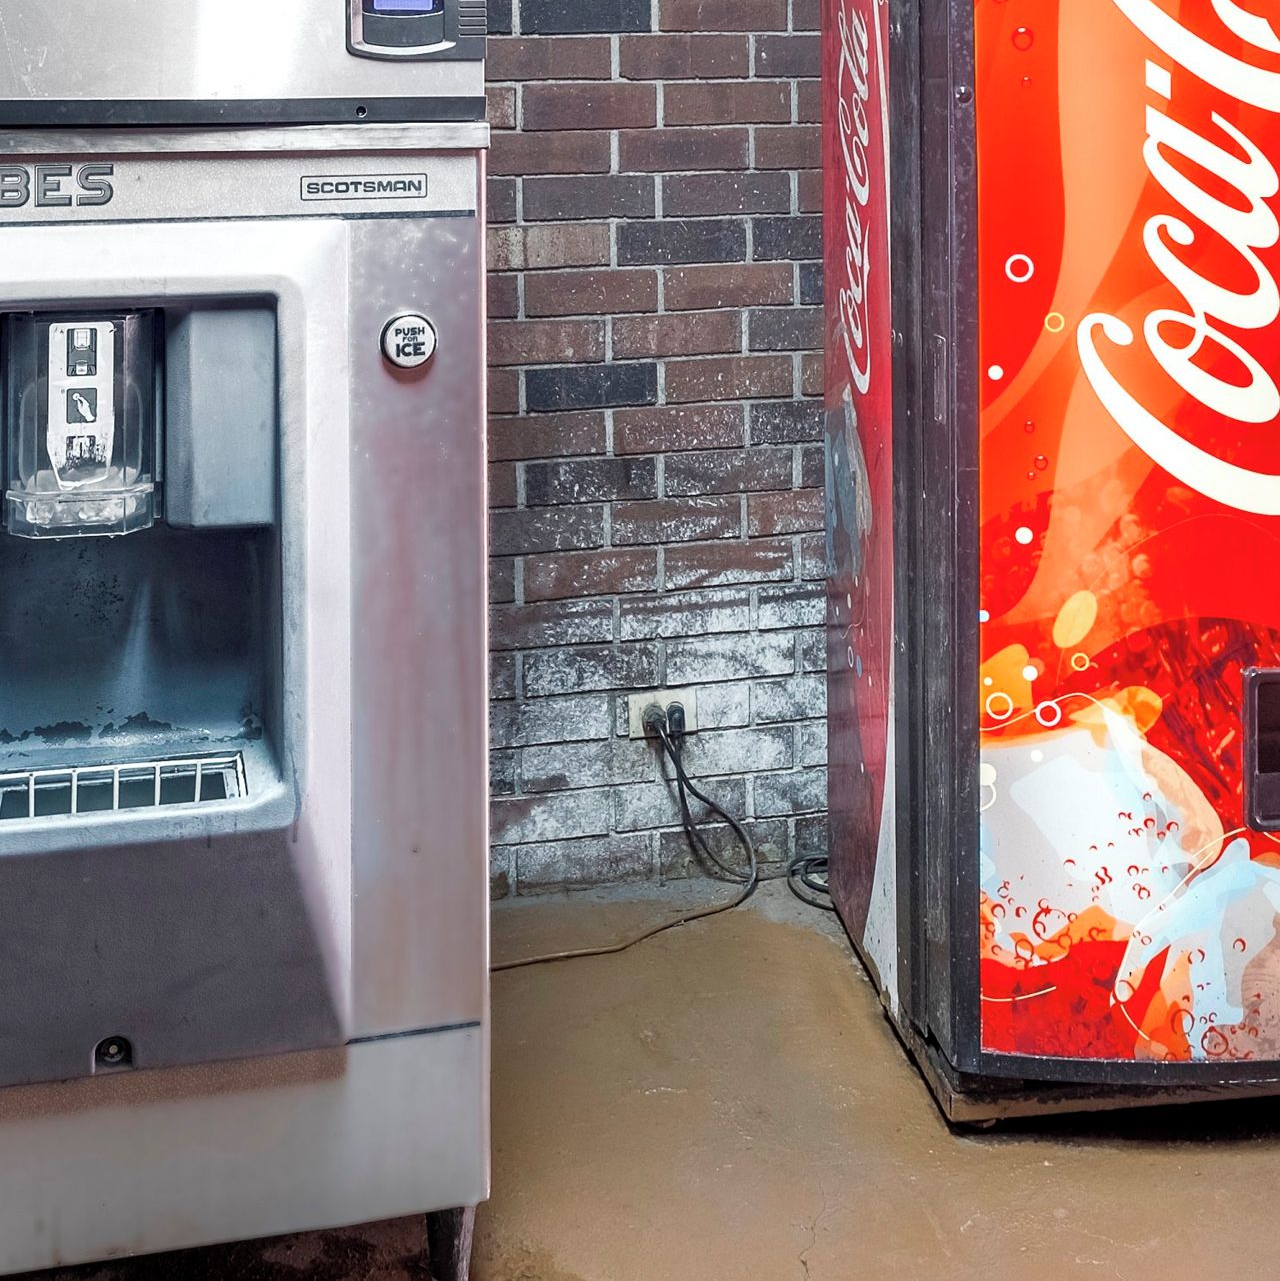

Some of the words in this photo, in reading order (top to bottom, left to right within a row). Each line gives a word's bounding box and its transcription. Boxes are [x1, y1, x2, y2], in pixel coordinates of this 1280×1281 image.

[306, 180, 422, 194] SCOTSMAN
[395, 326, 425, 337] PUSH
[396, 342, 426, 358] ICE
